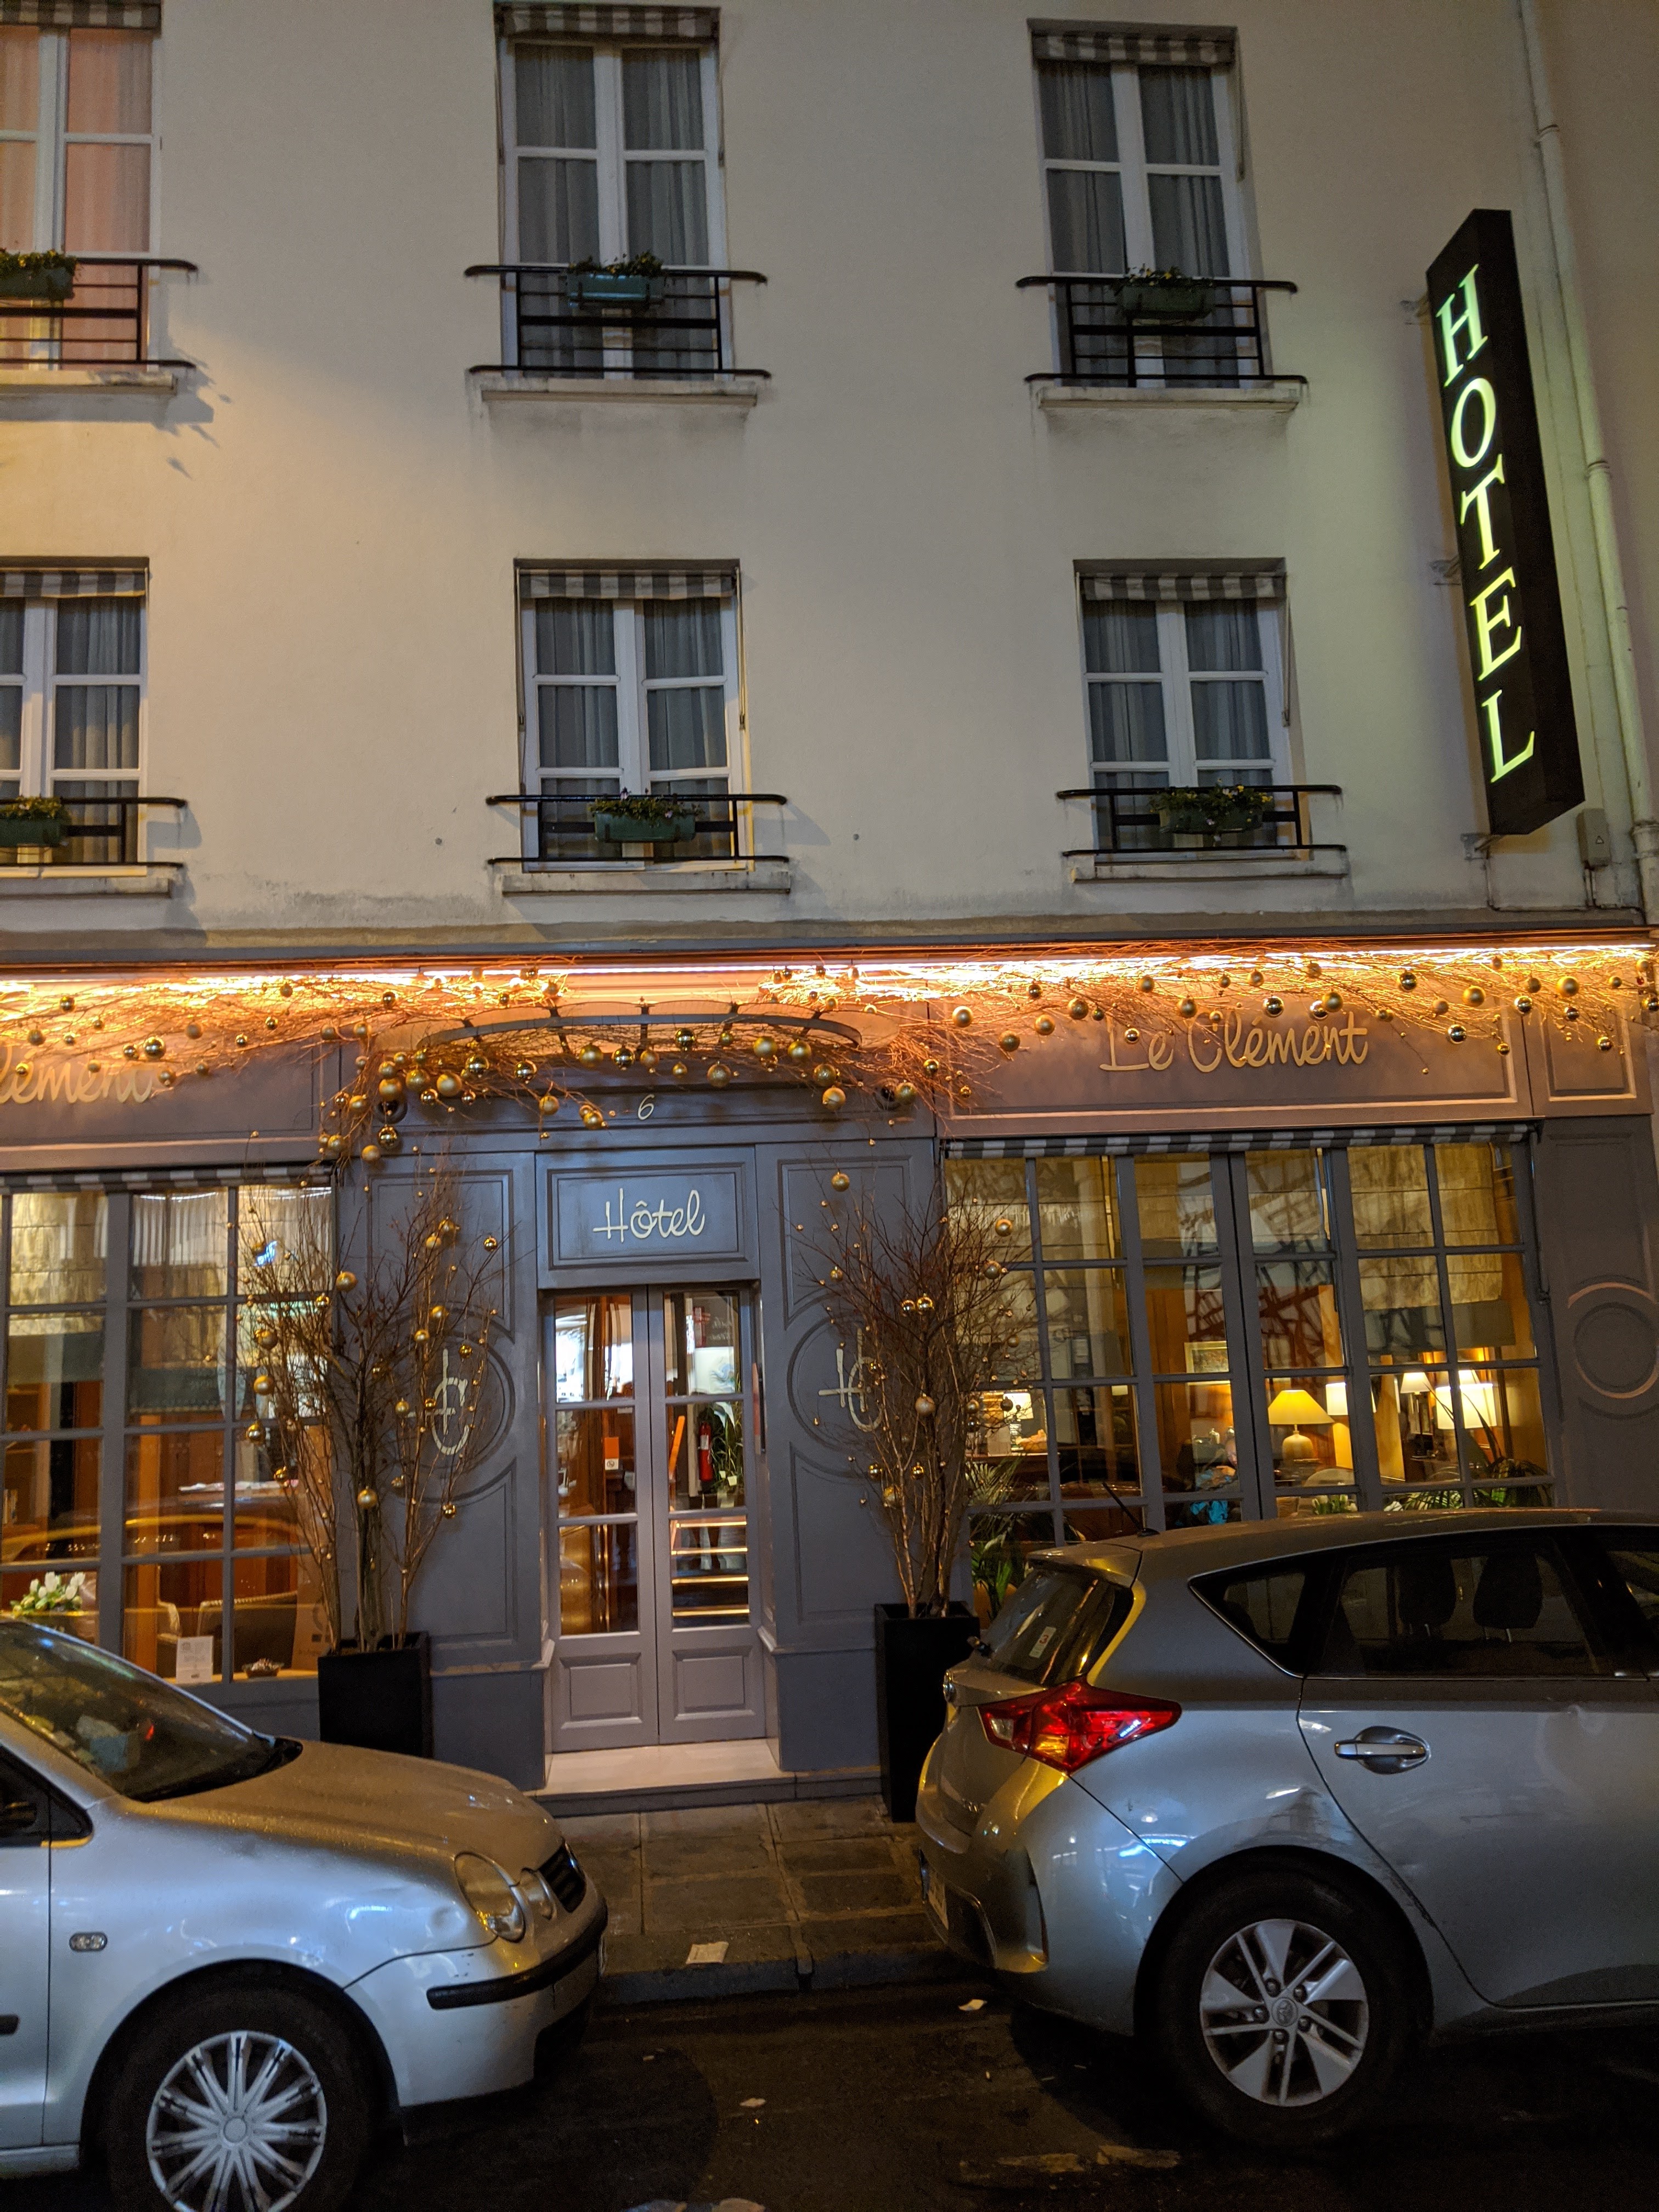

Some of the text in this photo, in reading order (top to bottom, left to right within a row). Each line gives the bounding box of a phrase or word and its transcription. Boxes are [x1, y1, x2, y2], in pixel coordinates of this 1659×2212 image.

[1436, 263, 1536, 783] HOTEL
[1099, 1009, 1368, 1073] Le Clément
[637, 1094, 655, 1120] 6
[592, 1187, 705, 1243] Hôtel
